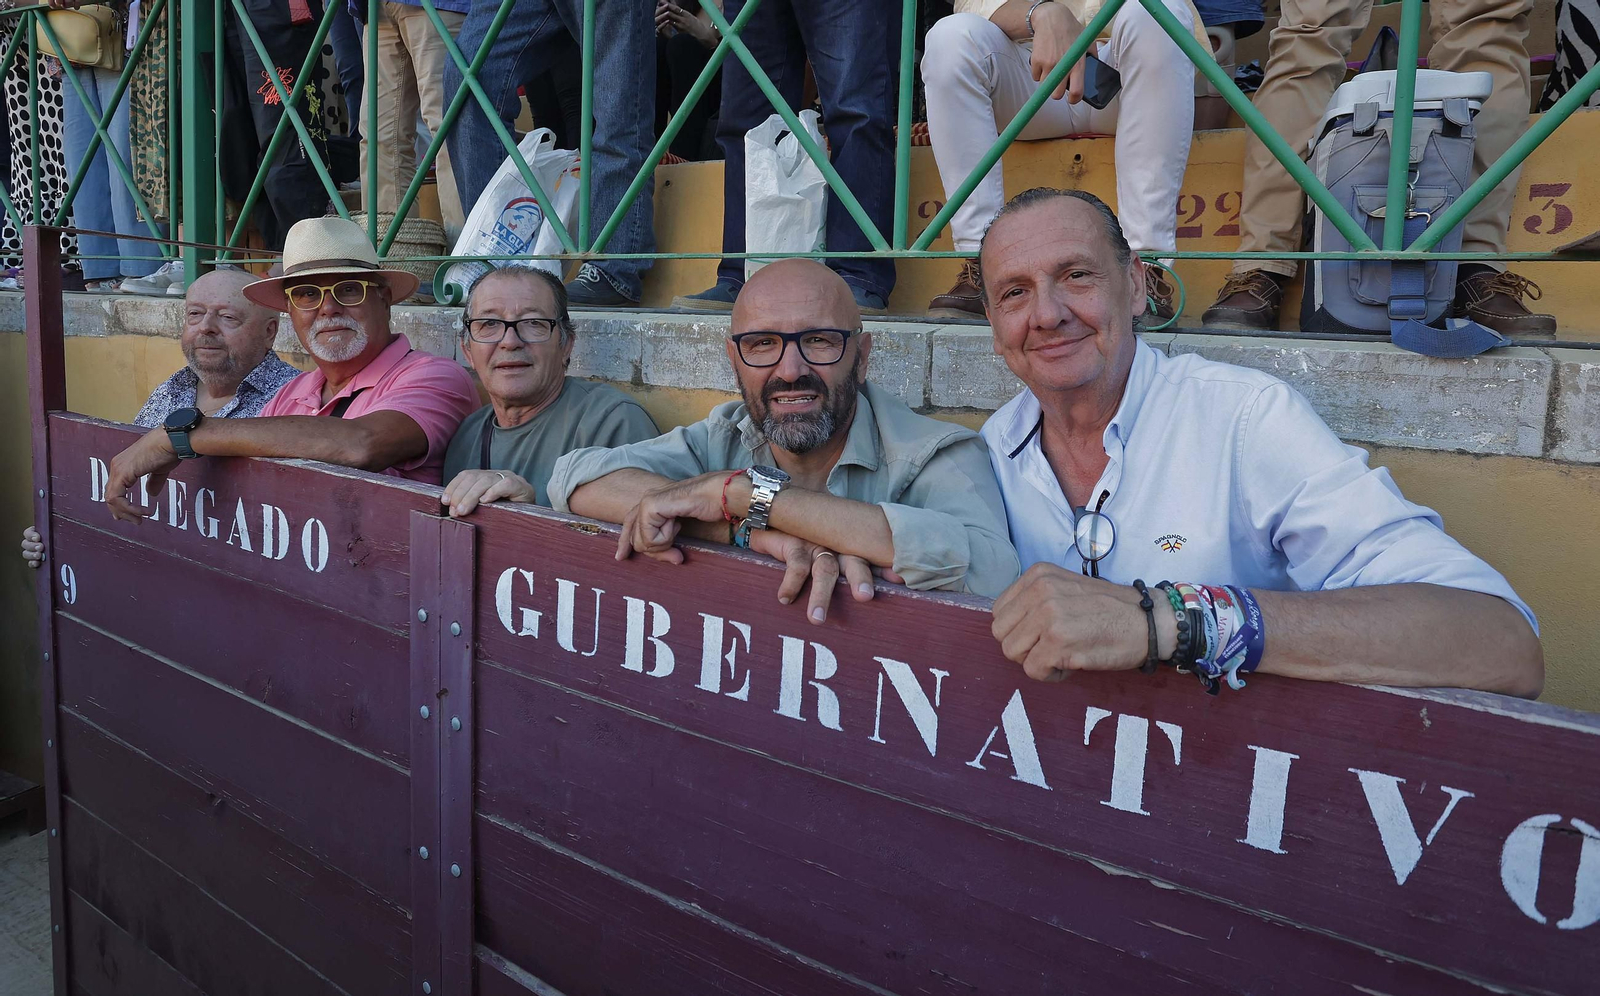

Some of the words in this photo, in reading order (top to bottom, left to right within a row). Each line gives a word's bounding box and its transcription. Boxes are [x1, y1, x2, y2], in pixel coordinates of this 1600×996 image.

[60, 563, 78, 605] 9
[89, 456, 330, 573] DLEGADO
[494, 566, 1600, 930] GUBERNATIVO
